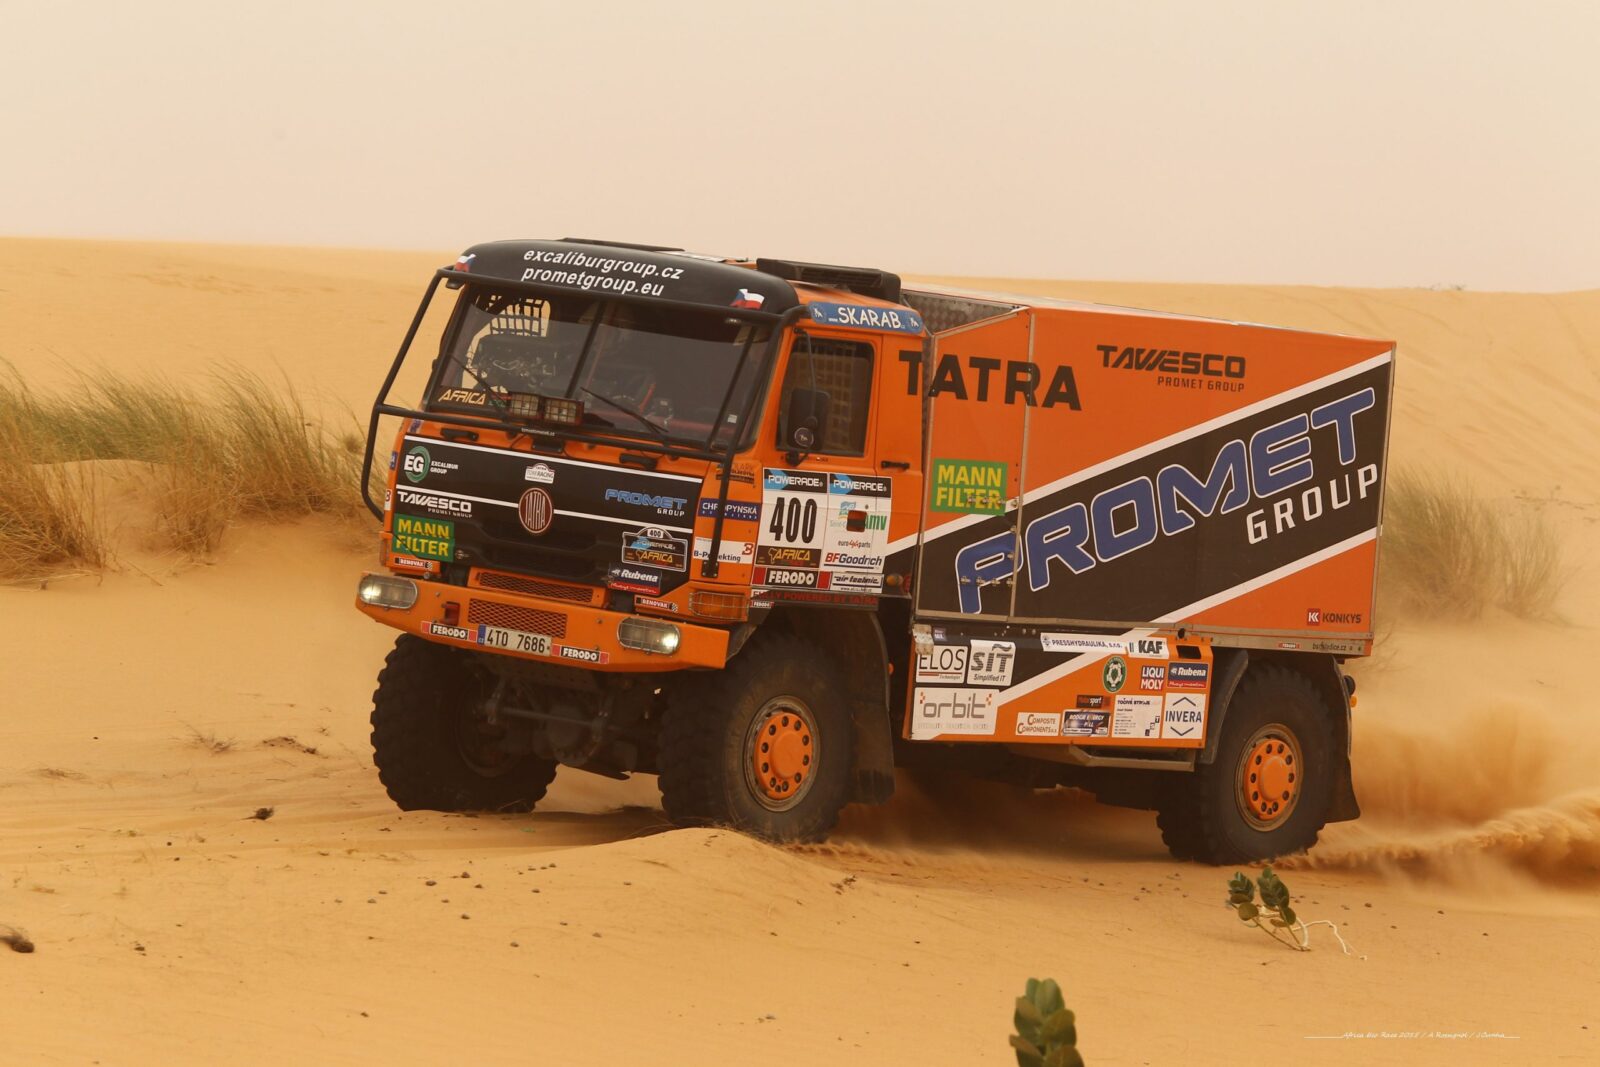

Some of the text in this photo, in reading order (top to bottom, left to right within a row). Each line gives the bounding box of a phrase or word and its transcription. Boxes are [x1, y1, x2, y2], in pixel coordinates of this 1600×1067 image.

[523, 249, 684, 280] excaliburgroup.cz
[521, 267, 664, 297] prometgroup.eu
[838, 307, 901, 329] SKARAB
[1096, 344, 1247, 379] TAWESCO
[898, 350, 1082, 411] TATRA
[1157, 376, 1246, 393] PROMET GROUP
[437, 388, 486, 406] AFRICA
[404, 454, 425, 473] EG
[768, 474, 819, 487] POWERADE
[938, 464, 1002, 488] MANN
[833, 479, 884, 492] POWERADE
[397, 490, 472, 513] TAWESCO
[604, 488, 688, 510] PROMET
[935, 486, 1001, 509] FILTER
[955, 386, 1376, 614] PROMET
[1245, 463, 1379, 545] GROUP
[524, 490, 546, 531] TATRA
[656, 508, 685, 518] GROUP
[702, 503, 757, 514] CHRPYNSKÁ
[398, 518, 450, 539] MANN
[769, 496, 818, 544] 400
[649, 530, 662, 538] 400
[396, 534, 449, 557] FILTER
[640, 550, 673, 563] AFRICA
[693, 550, 741, 562] B-Pekting
[773, 548, 811, 561] AFRICA
[825, 552, 883, 566] BFGoodrich
[620, 569, 659, 582] Rubena
[768, 570, 815, 586] FERODO
[1322, 612, 1362, 624] KONKYS
[432, 624, 468, 639] FERODO
[517, 634, 546, 653] 7686
[1138, 640, 1163, 654] KAF
[562, 647, 598, 661] FERODO
[918, 648, 965, 671] ELOS
[974, 674, 998, 682] Simplified
[1142, 666, 1165, 678] LIQUI
[1177, 666, 1207, 677] Rubena
[1140, 678, 1165, 690] MOLY
[923, 692, 987, 719] orbit
[1165, 710, 1202, 724] INVERA
